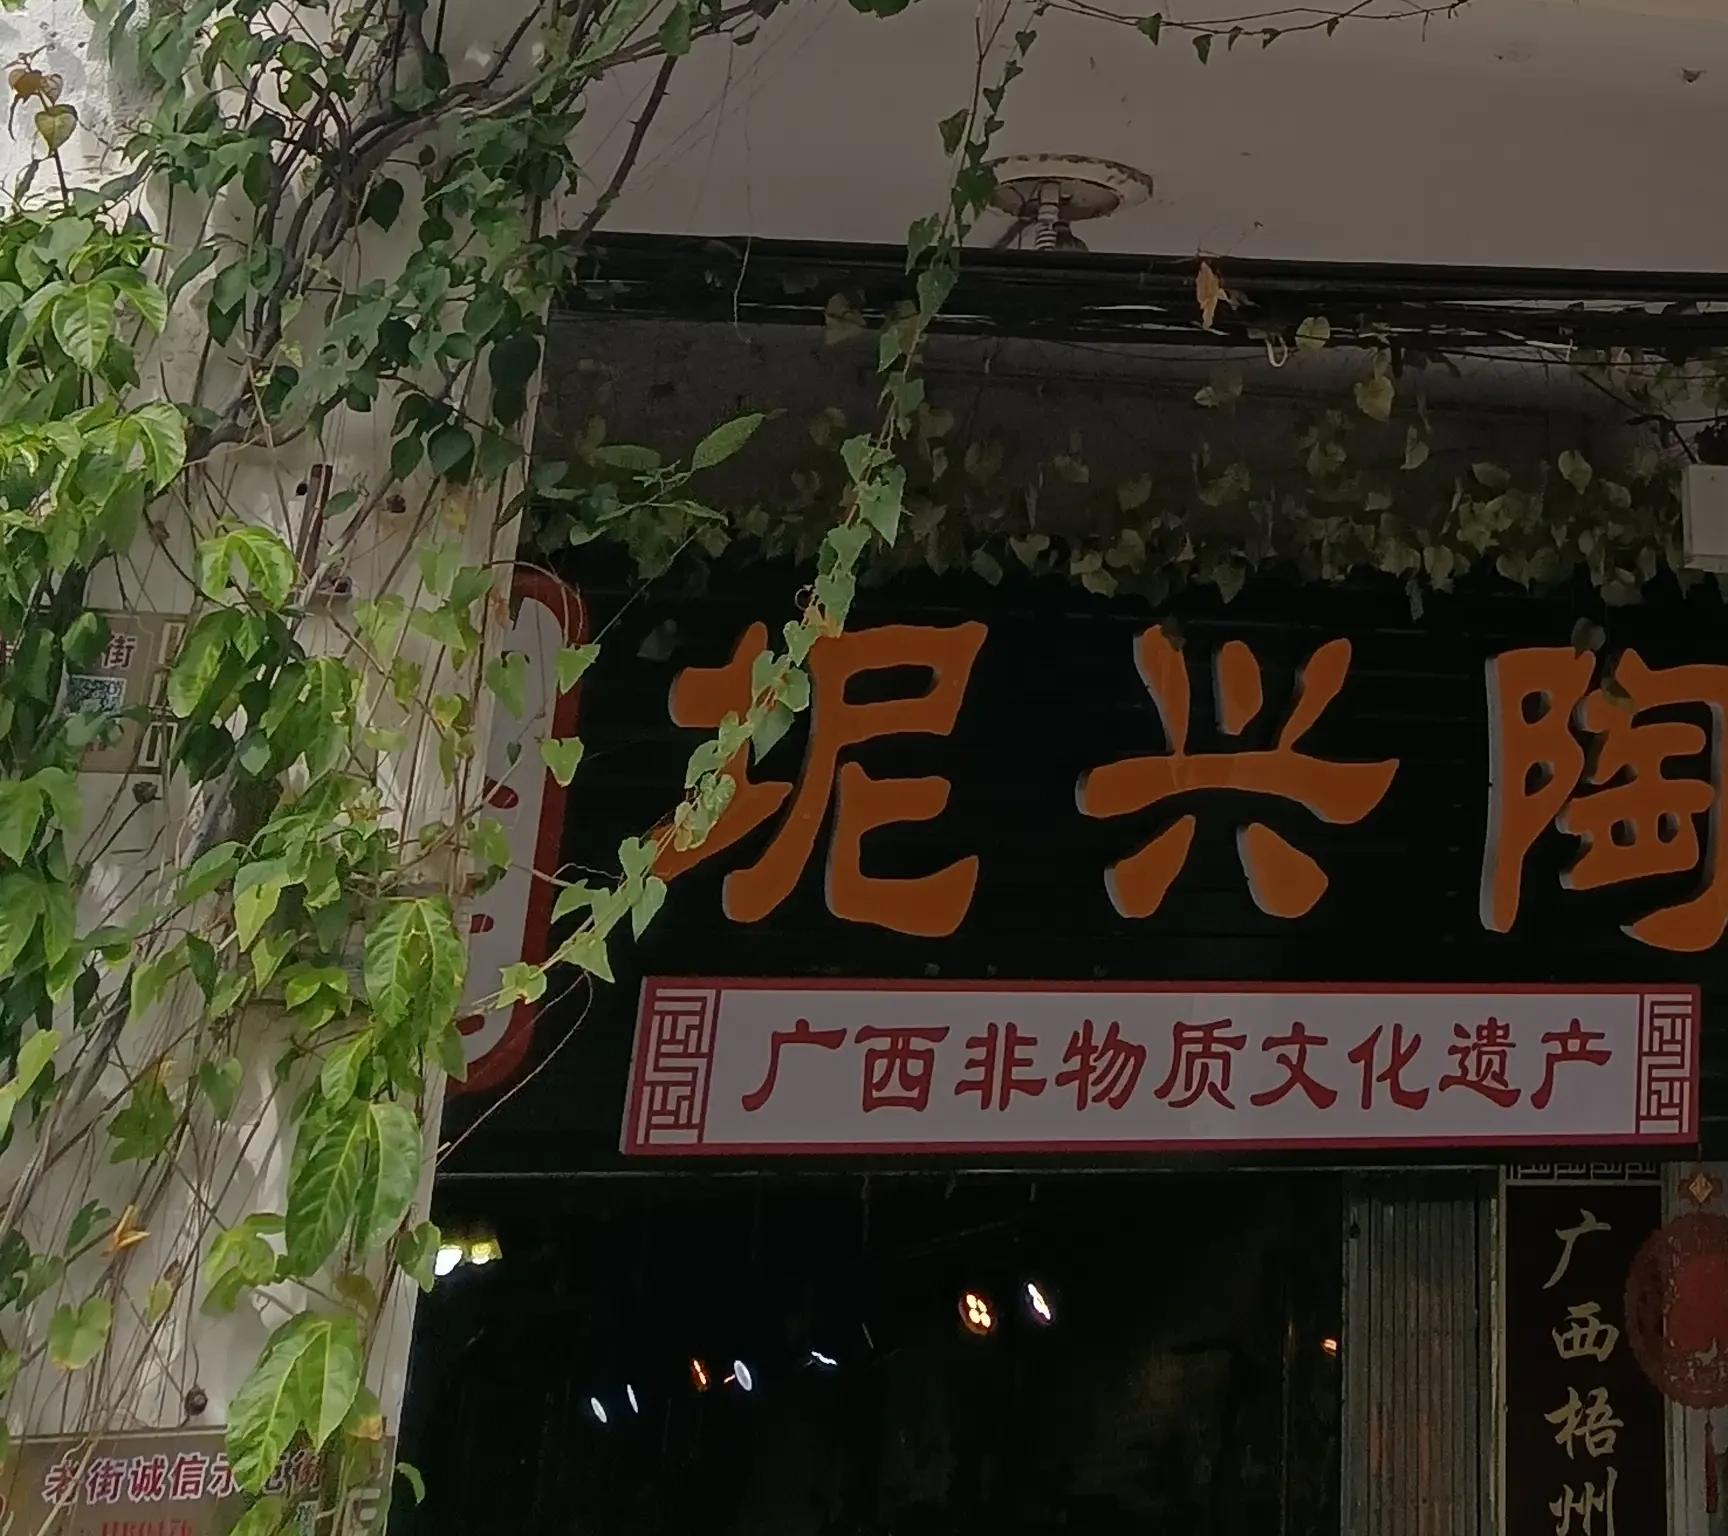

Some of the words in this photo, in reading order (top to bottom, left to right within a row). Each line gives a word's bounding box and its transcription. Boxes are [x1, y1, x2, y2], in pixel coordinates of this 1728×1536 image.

[742, 1018, 1613, 1113] 广西非物质文化遗产
[1541, 1208, 1624, 1536] 广西梧州
